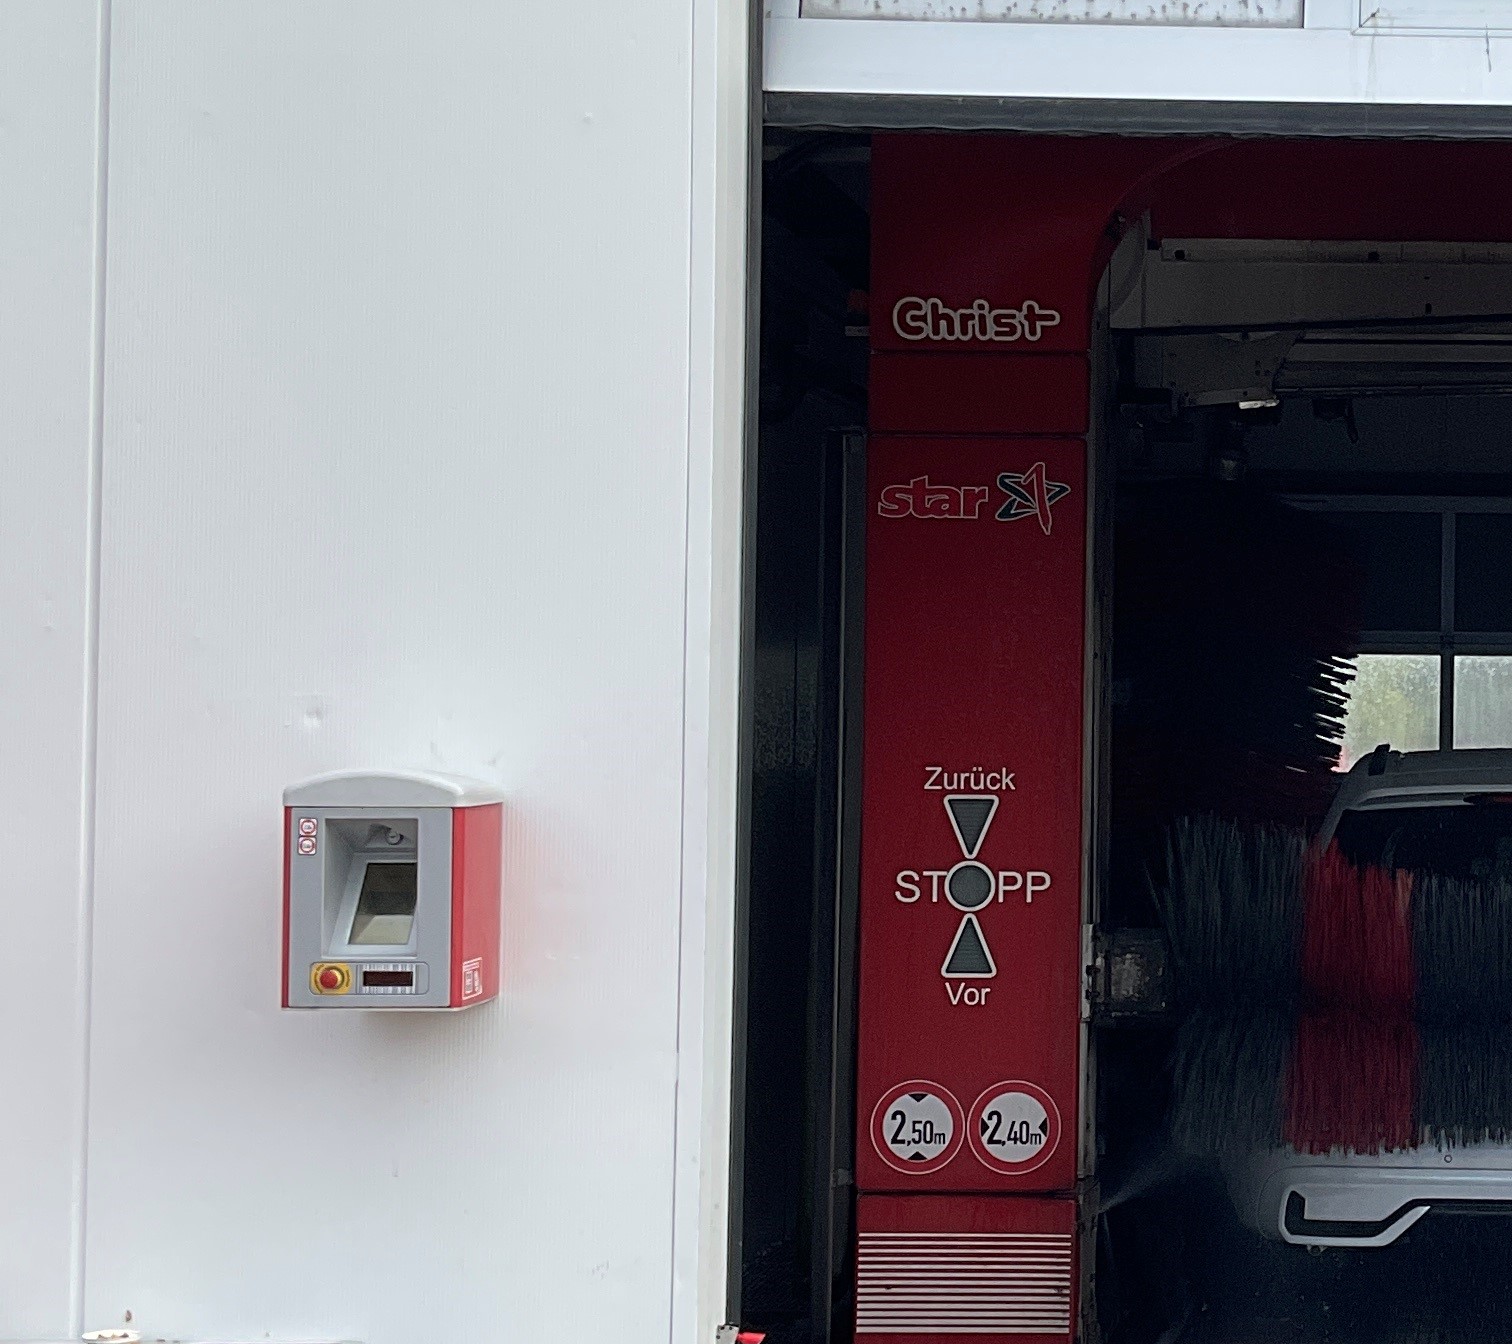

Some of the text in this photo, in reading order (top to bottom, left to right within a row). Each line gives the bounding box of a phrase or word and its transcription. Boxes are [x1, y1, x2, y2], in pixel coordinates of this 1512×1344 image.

[893, 296, 1061, 341] Christ
[877, 475, 989, 520] star
[923, 766, 1016, 791] Zurück
[894, 862, 1052, 911] STOPP
[944, 982, 991, 1006] Vor
